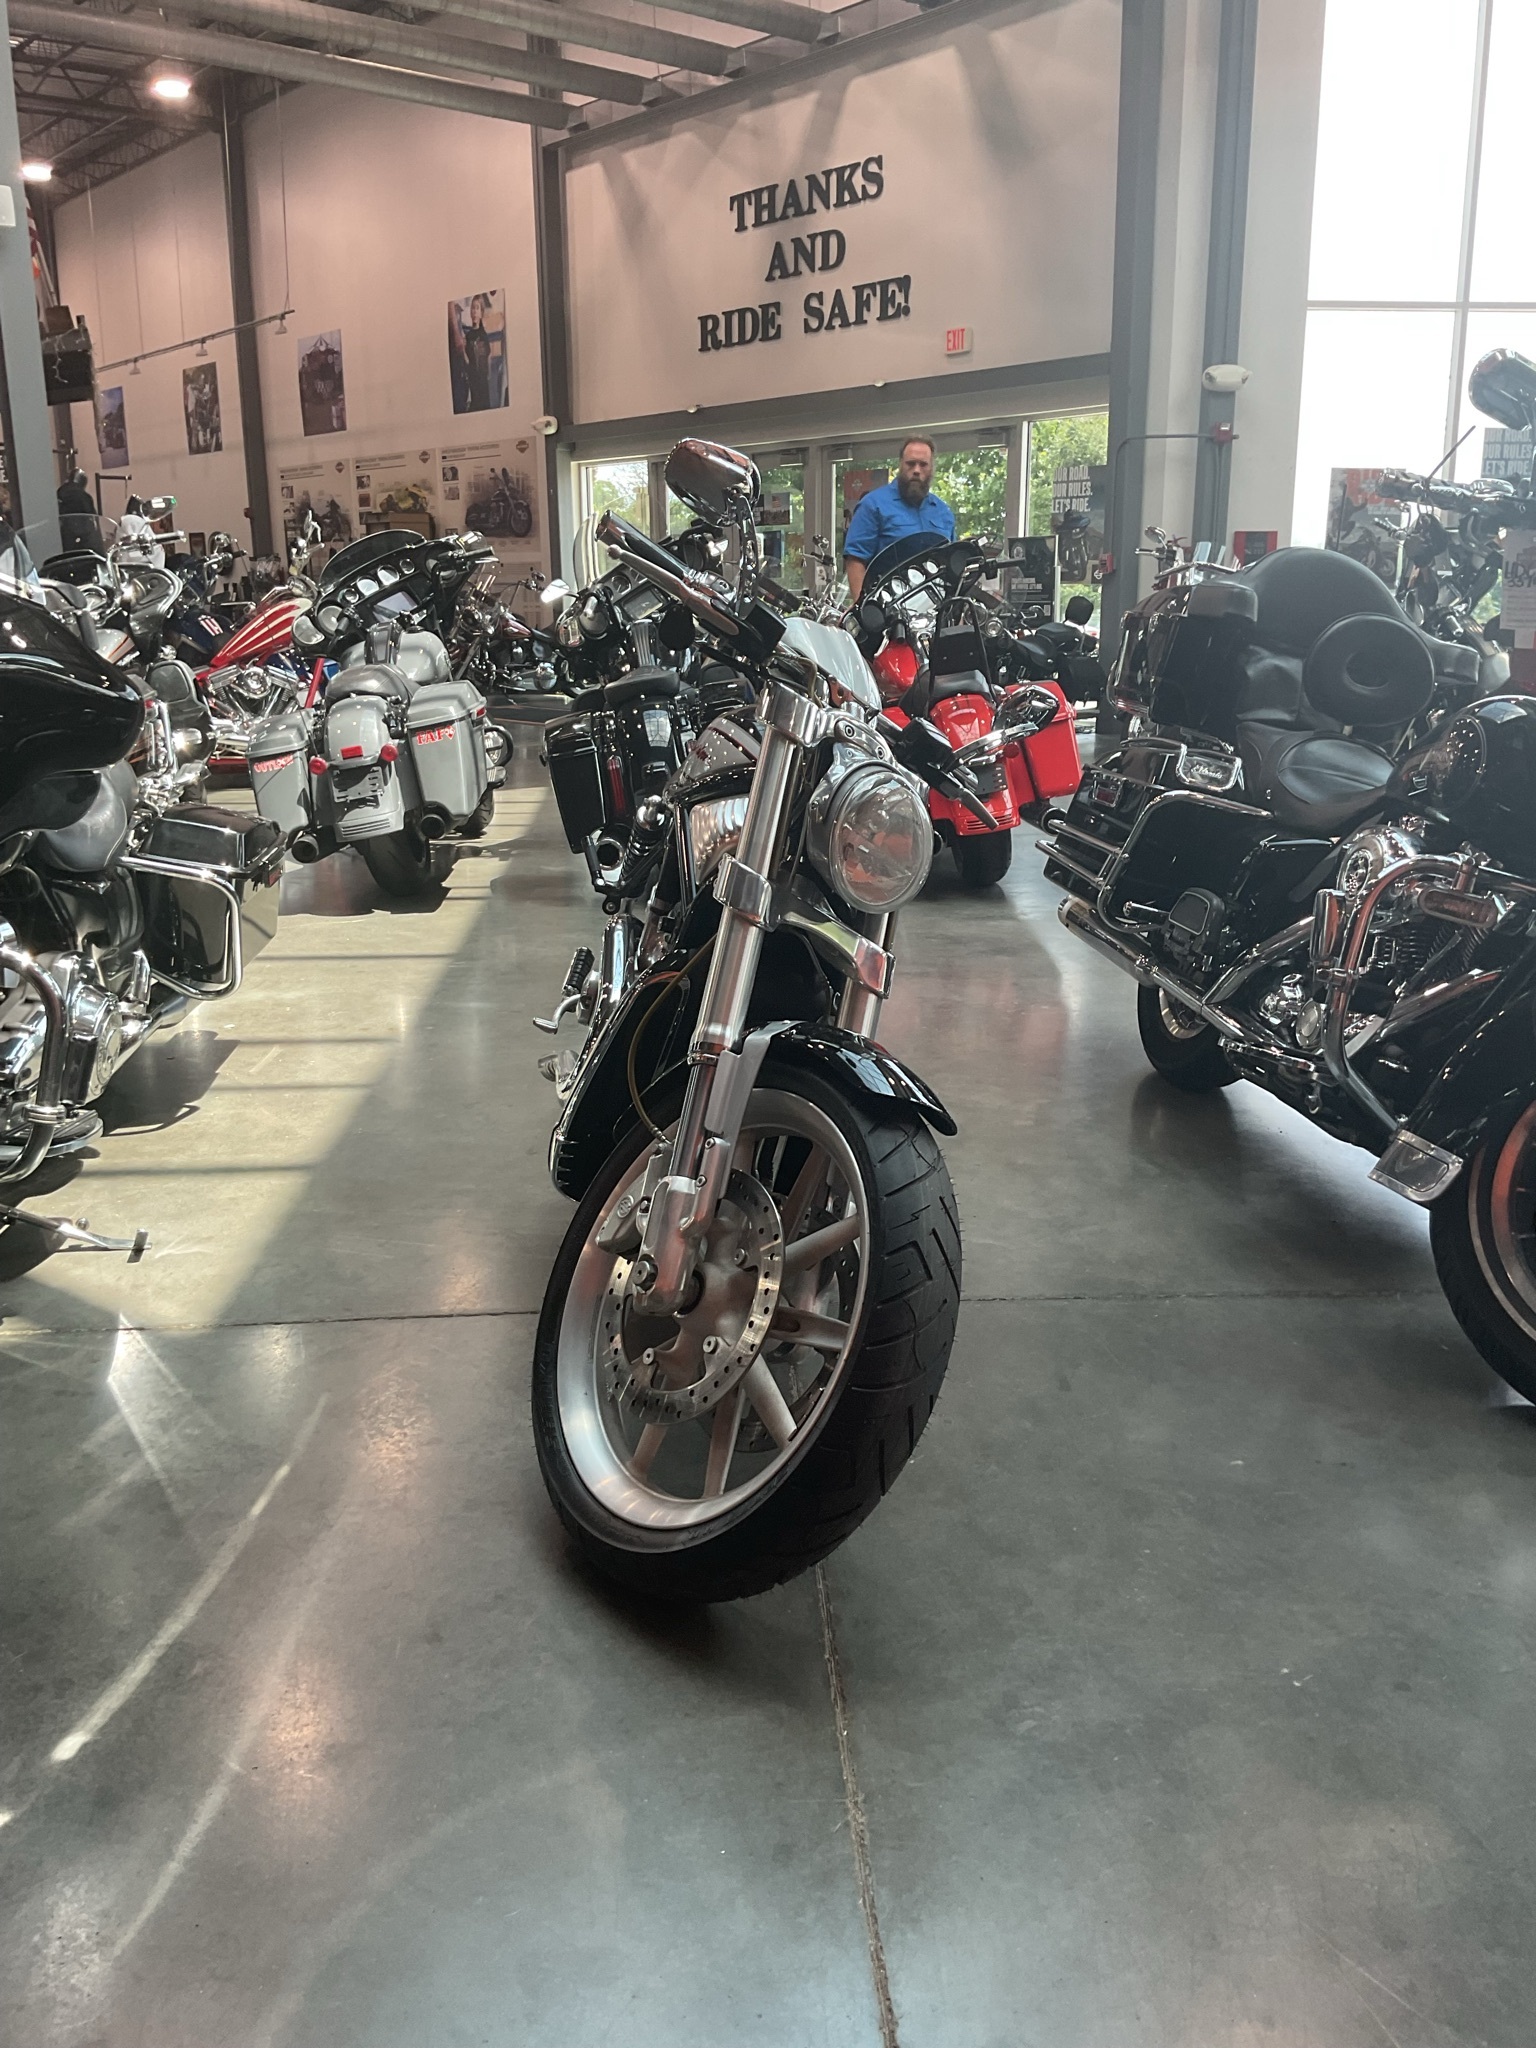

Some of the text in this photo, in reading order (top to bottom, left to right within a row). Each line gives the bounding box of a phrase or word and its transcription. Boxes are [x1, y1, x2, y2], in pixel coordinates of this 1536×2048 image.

[729, 155, 885, 233] THANKS
[764, 229, 846, 282] AND
[697, 274, 912, 352] RIDE SAFE!
[946, 327, 965, 352] EXIT
[1069, 464, 1090, 480] ROAD.
[1052, 481, 1093, 498] OUR RULES.
[1051, 498, 1071, 513] LET'S
